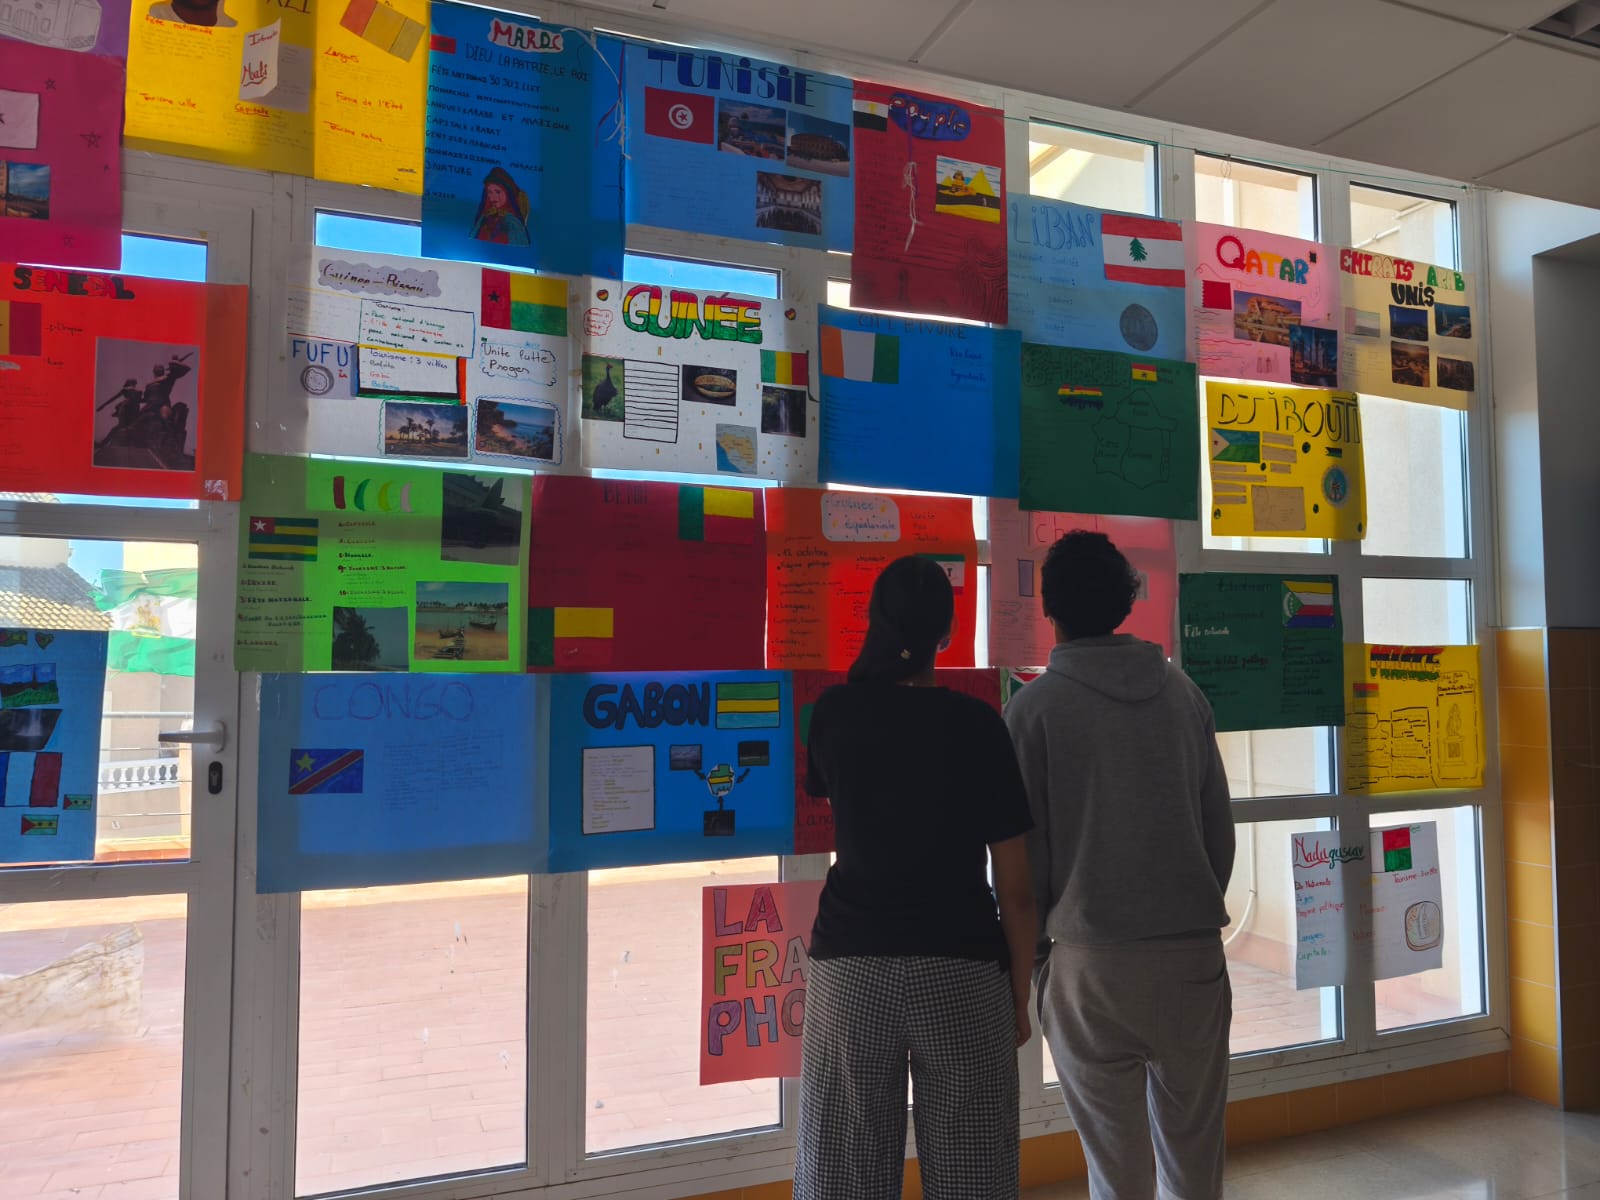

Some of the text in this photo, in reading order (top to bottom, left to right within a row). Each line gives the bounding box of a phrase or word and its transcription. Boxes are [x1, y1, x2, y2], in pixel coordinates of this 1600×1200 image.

[465, 42, 491, 64] DIEU
[492, 19, 563, 51] MAROC
[501, 114, 515, 122] ET
[1216, 235, 1309, 285] QATAR
[313, 681, 475, 721] CONGO
[583, 681, 711, 731] GABON
[713, 887, 784, 938] LA
